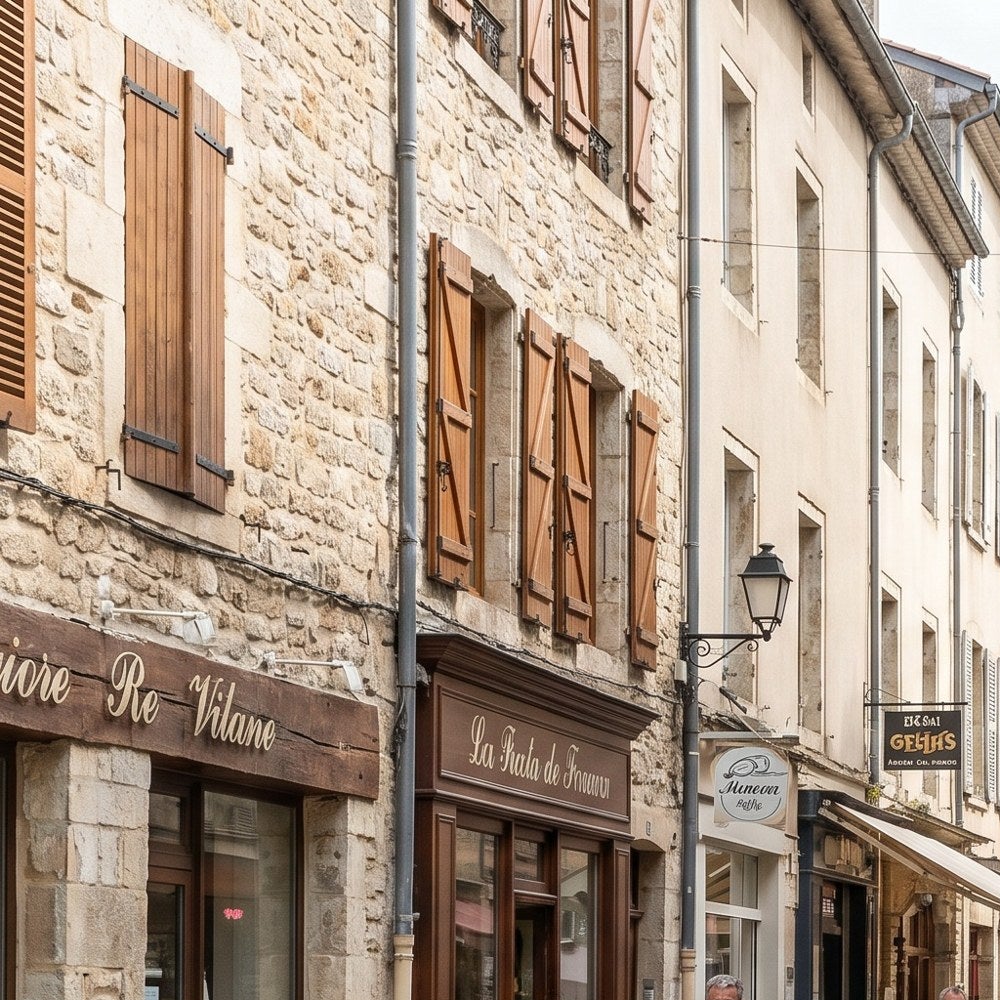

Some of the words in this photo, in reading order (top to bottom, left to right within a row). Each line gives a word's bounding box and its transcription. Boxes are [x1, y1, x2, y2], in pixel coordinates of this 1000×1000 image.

[107, 651, 160, 725] Re
[469, 715, 496, 770] La
[544, 742, 561, 786] de
